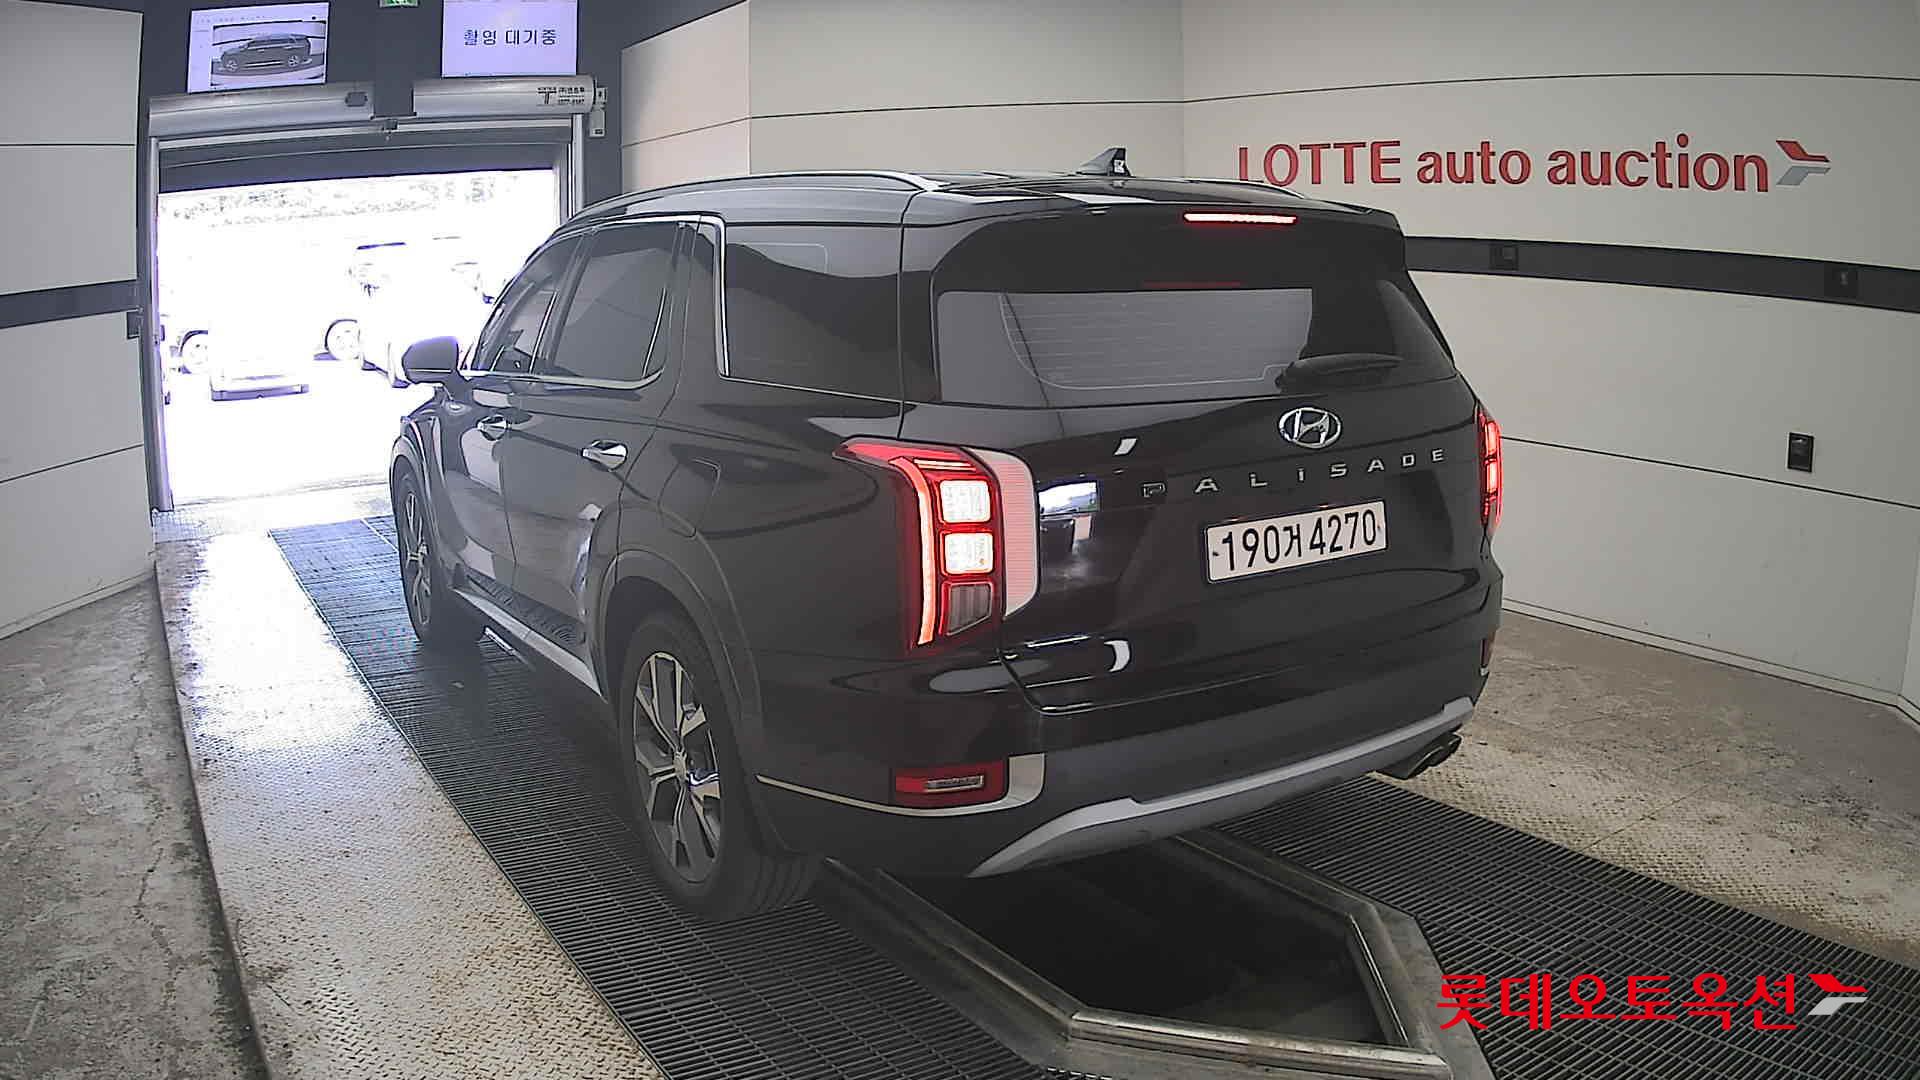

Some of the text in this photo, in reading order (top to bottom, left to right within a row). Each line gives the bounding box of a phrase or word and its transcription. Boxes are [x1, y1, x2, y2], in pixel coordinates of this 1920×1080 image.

[505, 29, 557, 46] 대기중
[1239, 135, 1768, 190] LOTTE auto auction
[1142, 448, 1446, 497] PALISADE
